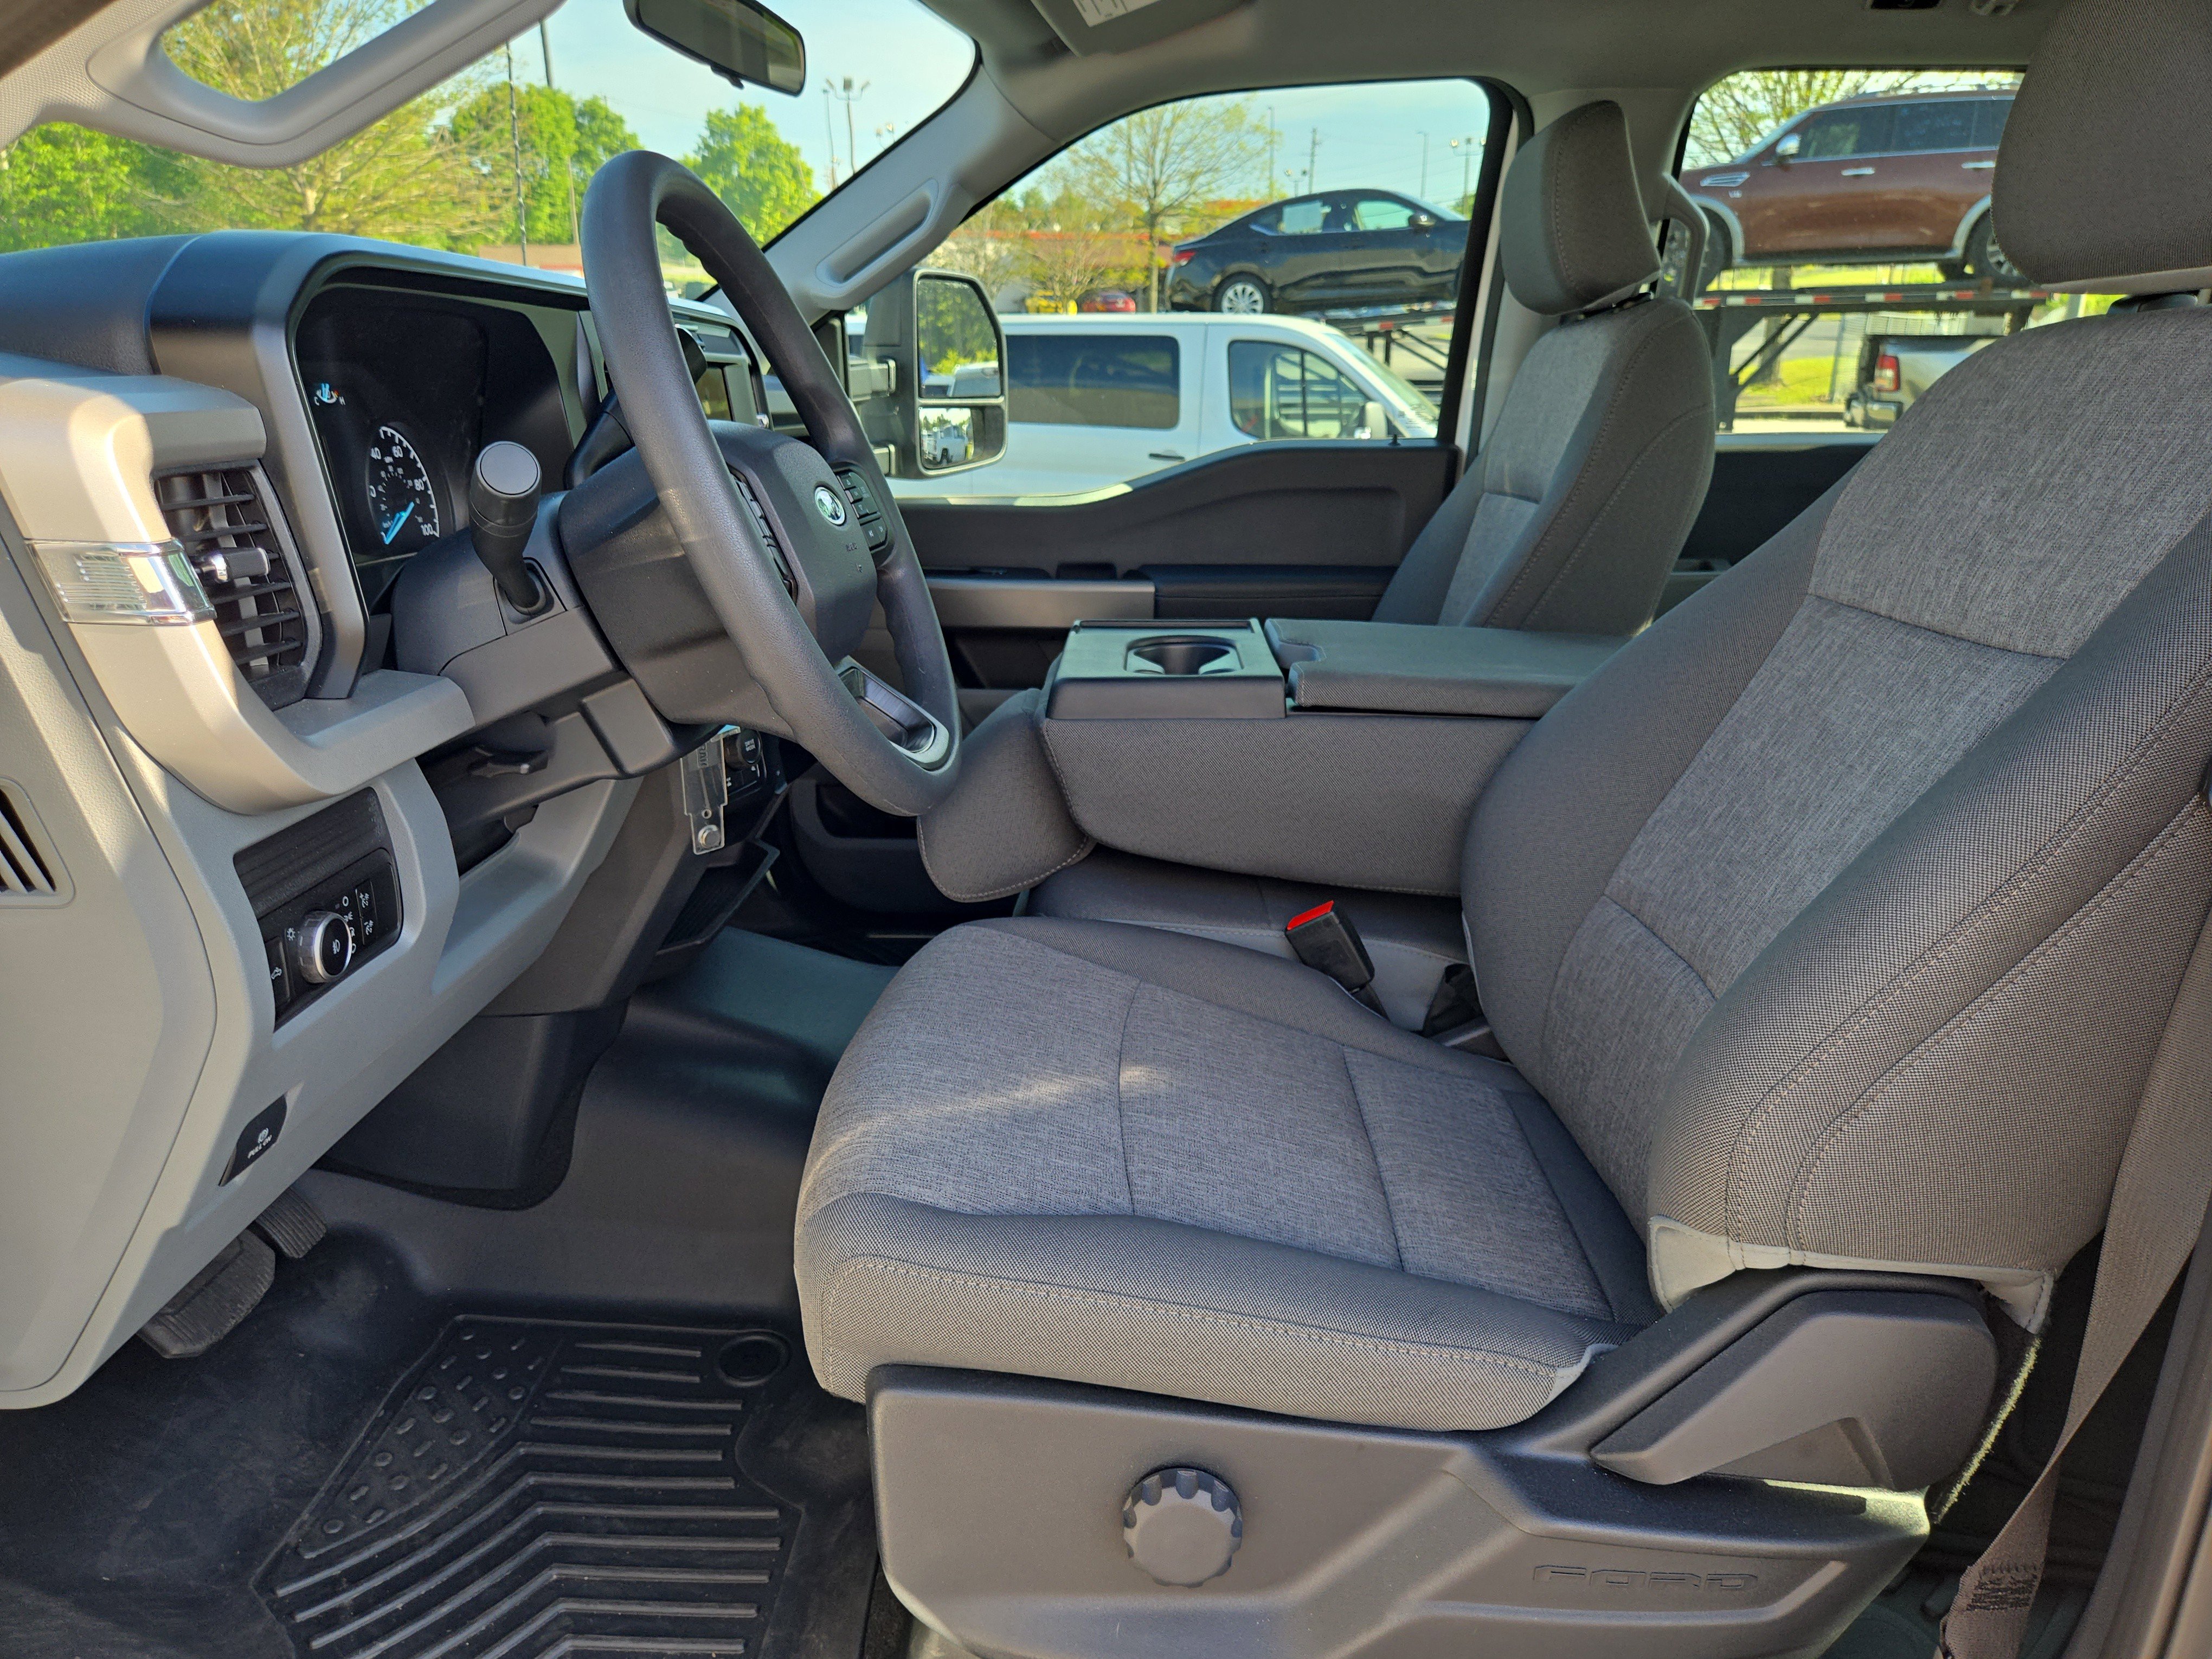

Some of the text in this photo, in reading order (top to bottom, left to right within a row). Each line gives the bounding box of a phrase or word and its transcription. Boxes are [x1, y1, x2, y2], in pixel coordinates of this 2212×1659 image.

[370, 447, 382, 460] 40
[392, 445, 403, 458] 60
[414, 478, 425, 491] 80
[421, 523, 434, 536] 100
[1533, 1564, 1758, 1591] FORD
